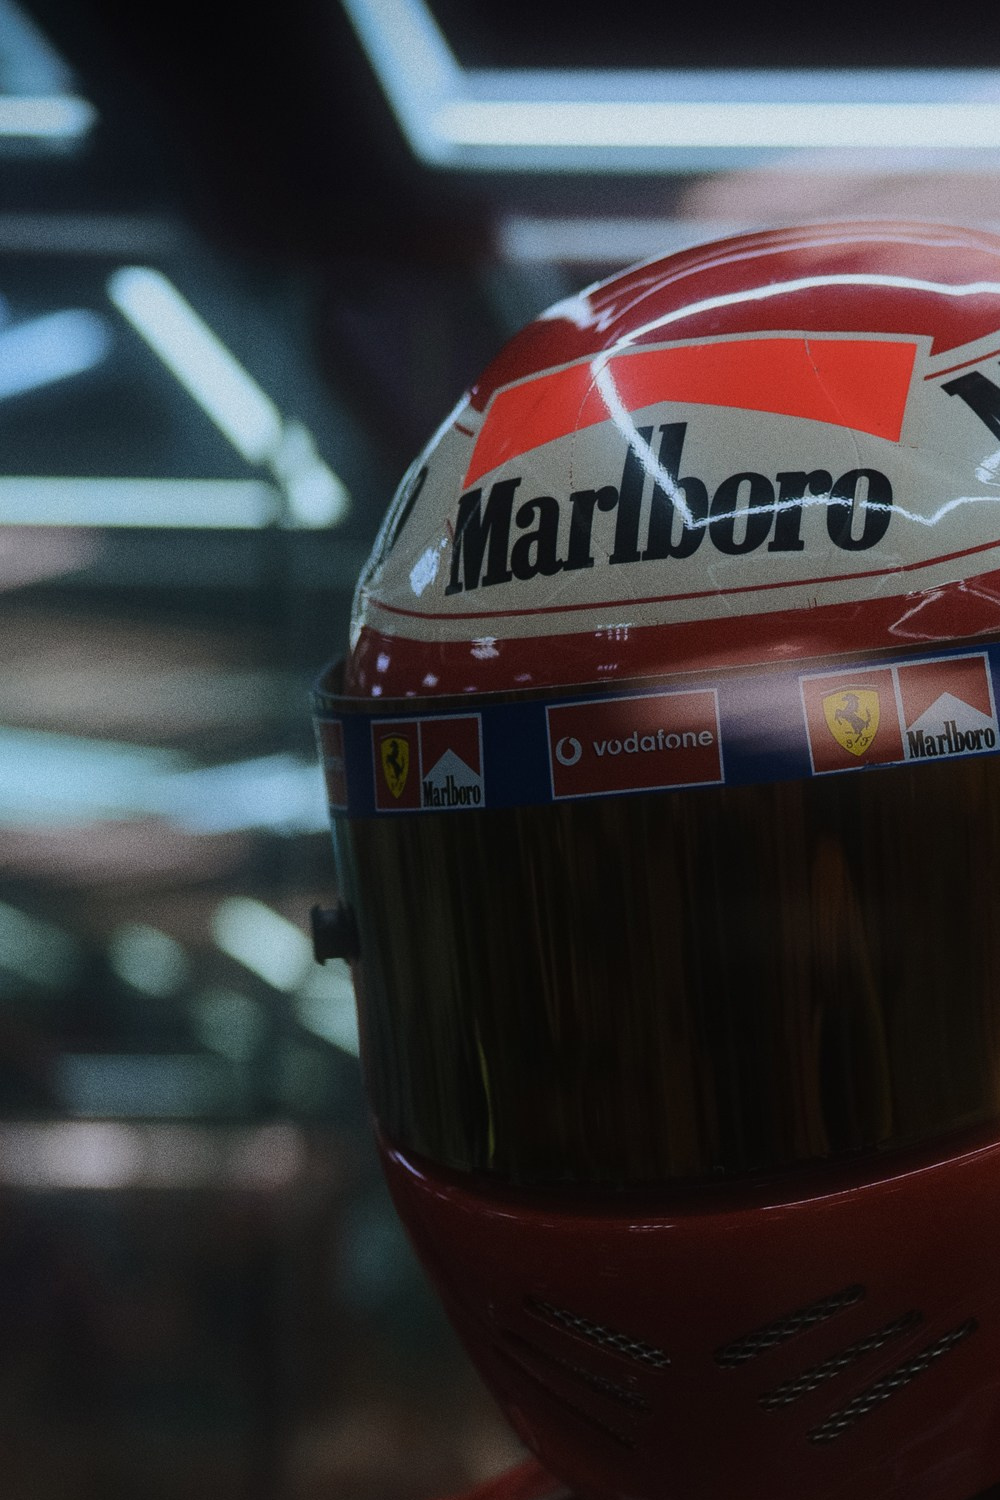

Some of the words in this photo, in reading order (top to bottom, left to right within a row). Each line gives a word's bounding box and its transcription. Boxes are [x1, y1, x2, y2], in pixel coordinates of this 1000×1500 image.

[445, 422, 893, 595] Marlboro
[593, 729, 714, 757] vodafone
[908, 720, 996, 760] Marlboro
[422, 775, 481, 807] Marlboro
